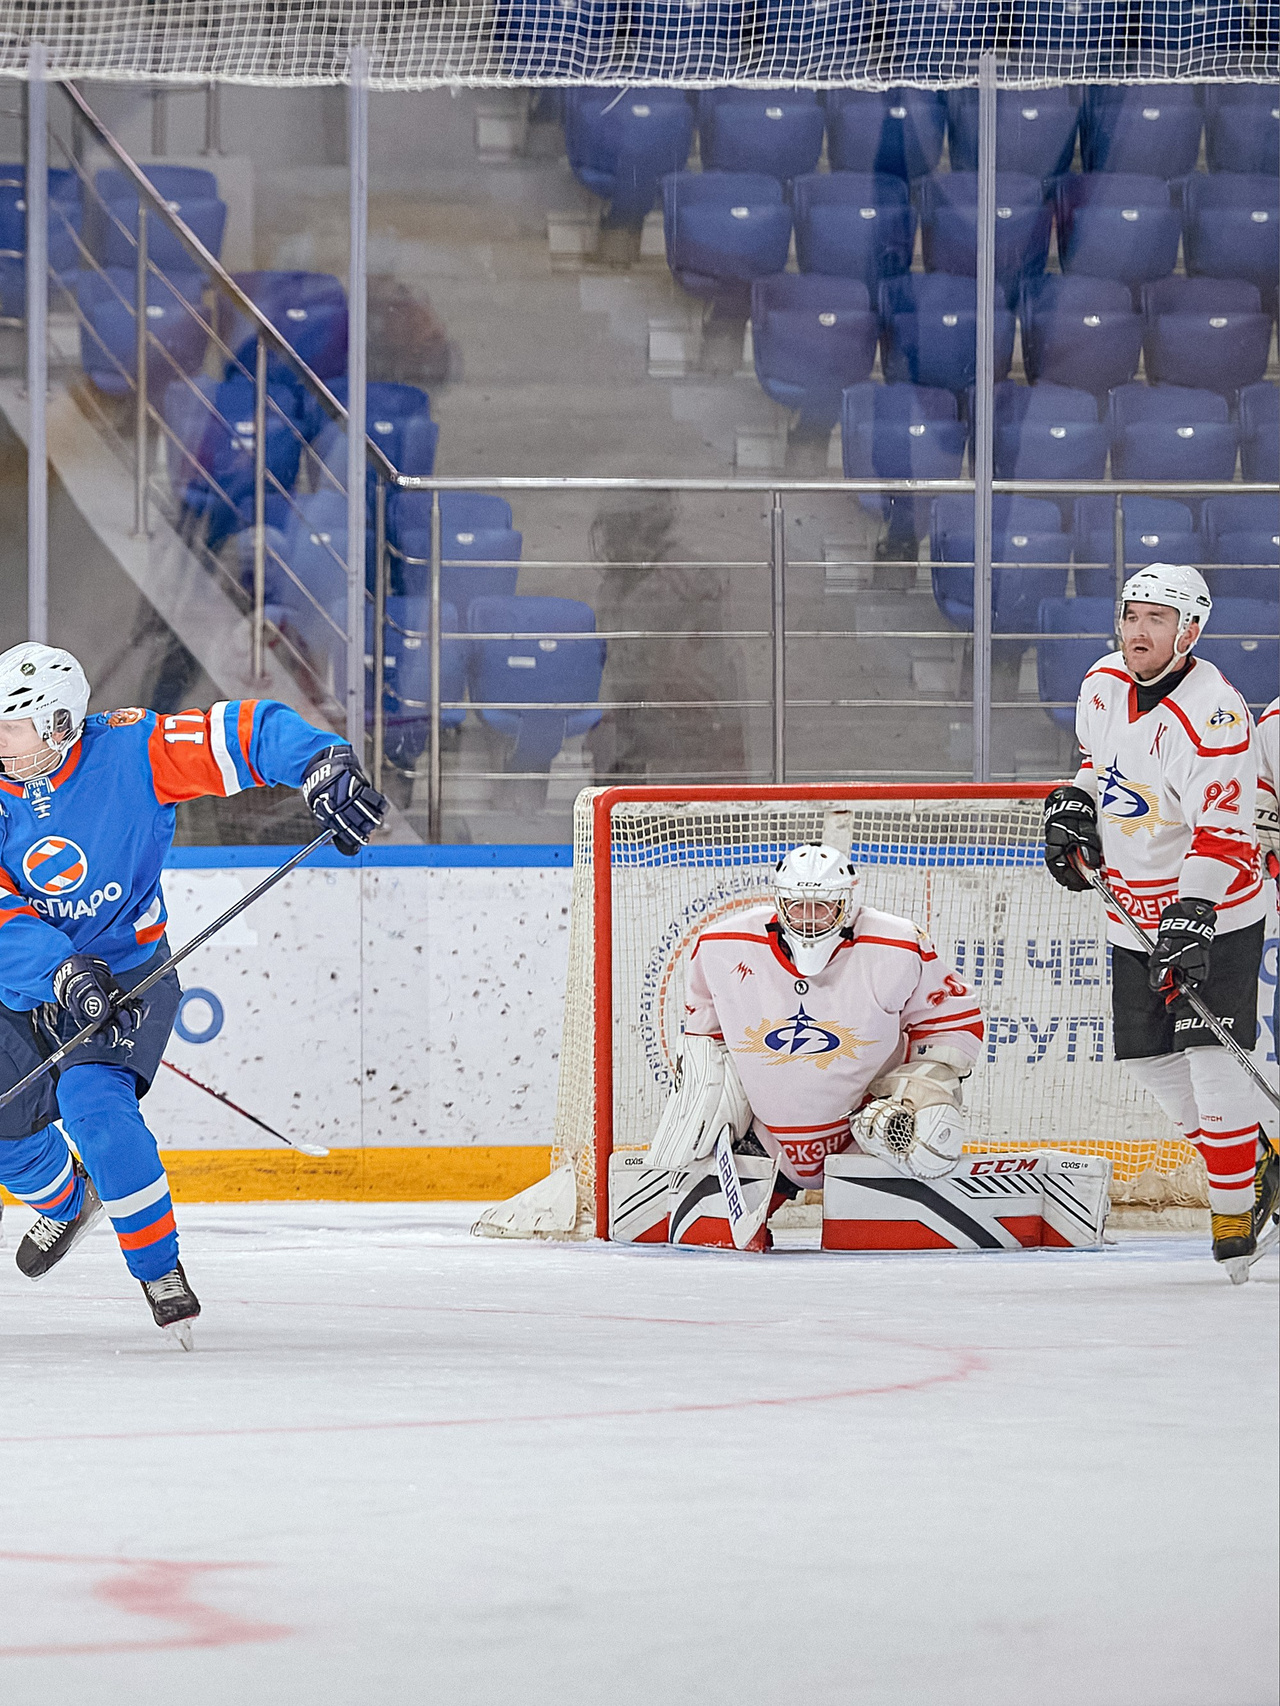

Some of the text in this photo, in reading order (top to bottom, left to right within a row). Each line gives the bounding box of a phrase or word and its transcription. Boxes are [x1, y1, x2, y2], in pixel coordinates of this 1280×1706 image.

[164, 714, 205, 745] 17
[1159, 917, 1216, 939] BAUE
[969, 1158, 1040, 1176] CCM
[718, 1150, 744, 1227] BAUER
